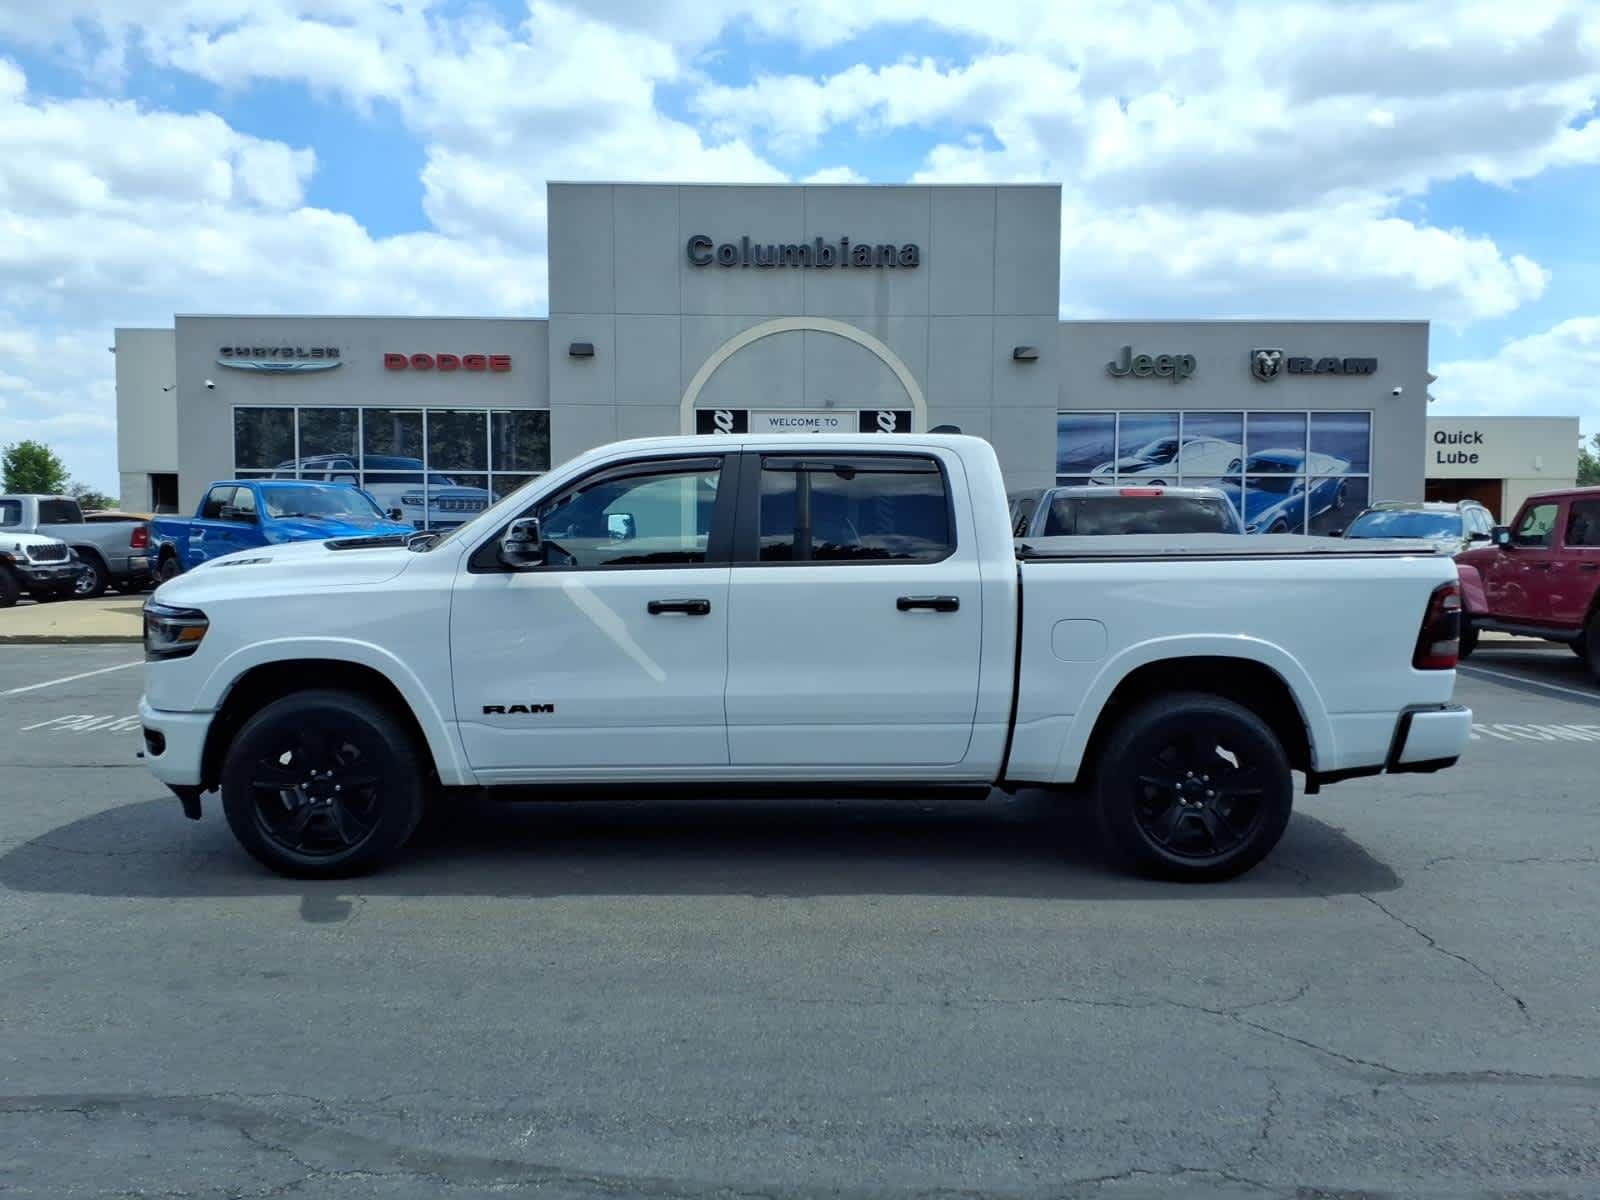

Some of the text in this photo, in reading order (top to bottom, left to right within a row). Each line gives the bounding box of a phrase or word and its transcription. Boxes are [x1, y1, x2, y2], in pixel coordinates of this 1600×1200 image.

[686, 234, 921, 268] Columbiana
[219, 346, 340, 359] CHRYSLER
[384, 353, 512, 371] DODGE
[1106, 345, 1197, 384] Jeep
[1287, 357, 1378, 375] RAM
[768, 418, 839, 426] WELCOME TO
[1433, 430, 1484, 444] Quick
[1436, 451, 1480, 464] Lube
[483, 703, 554, 714] RAM
